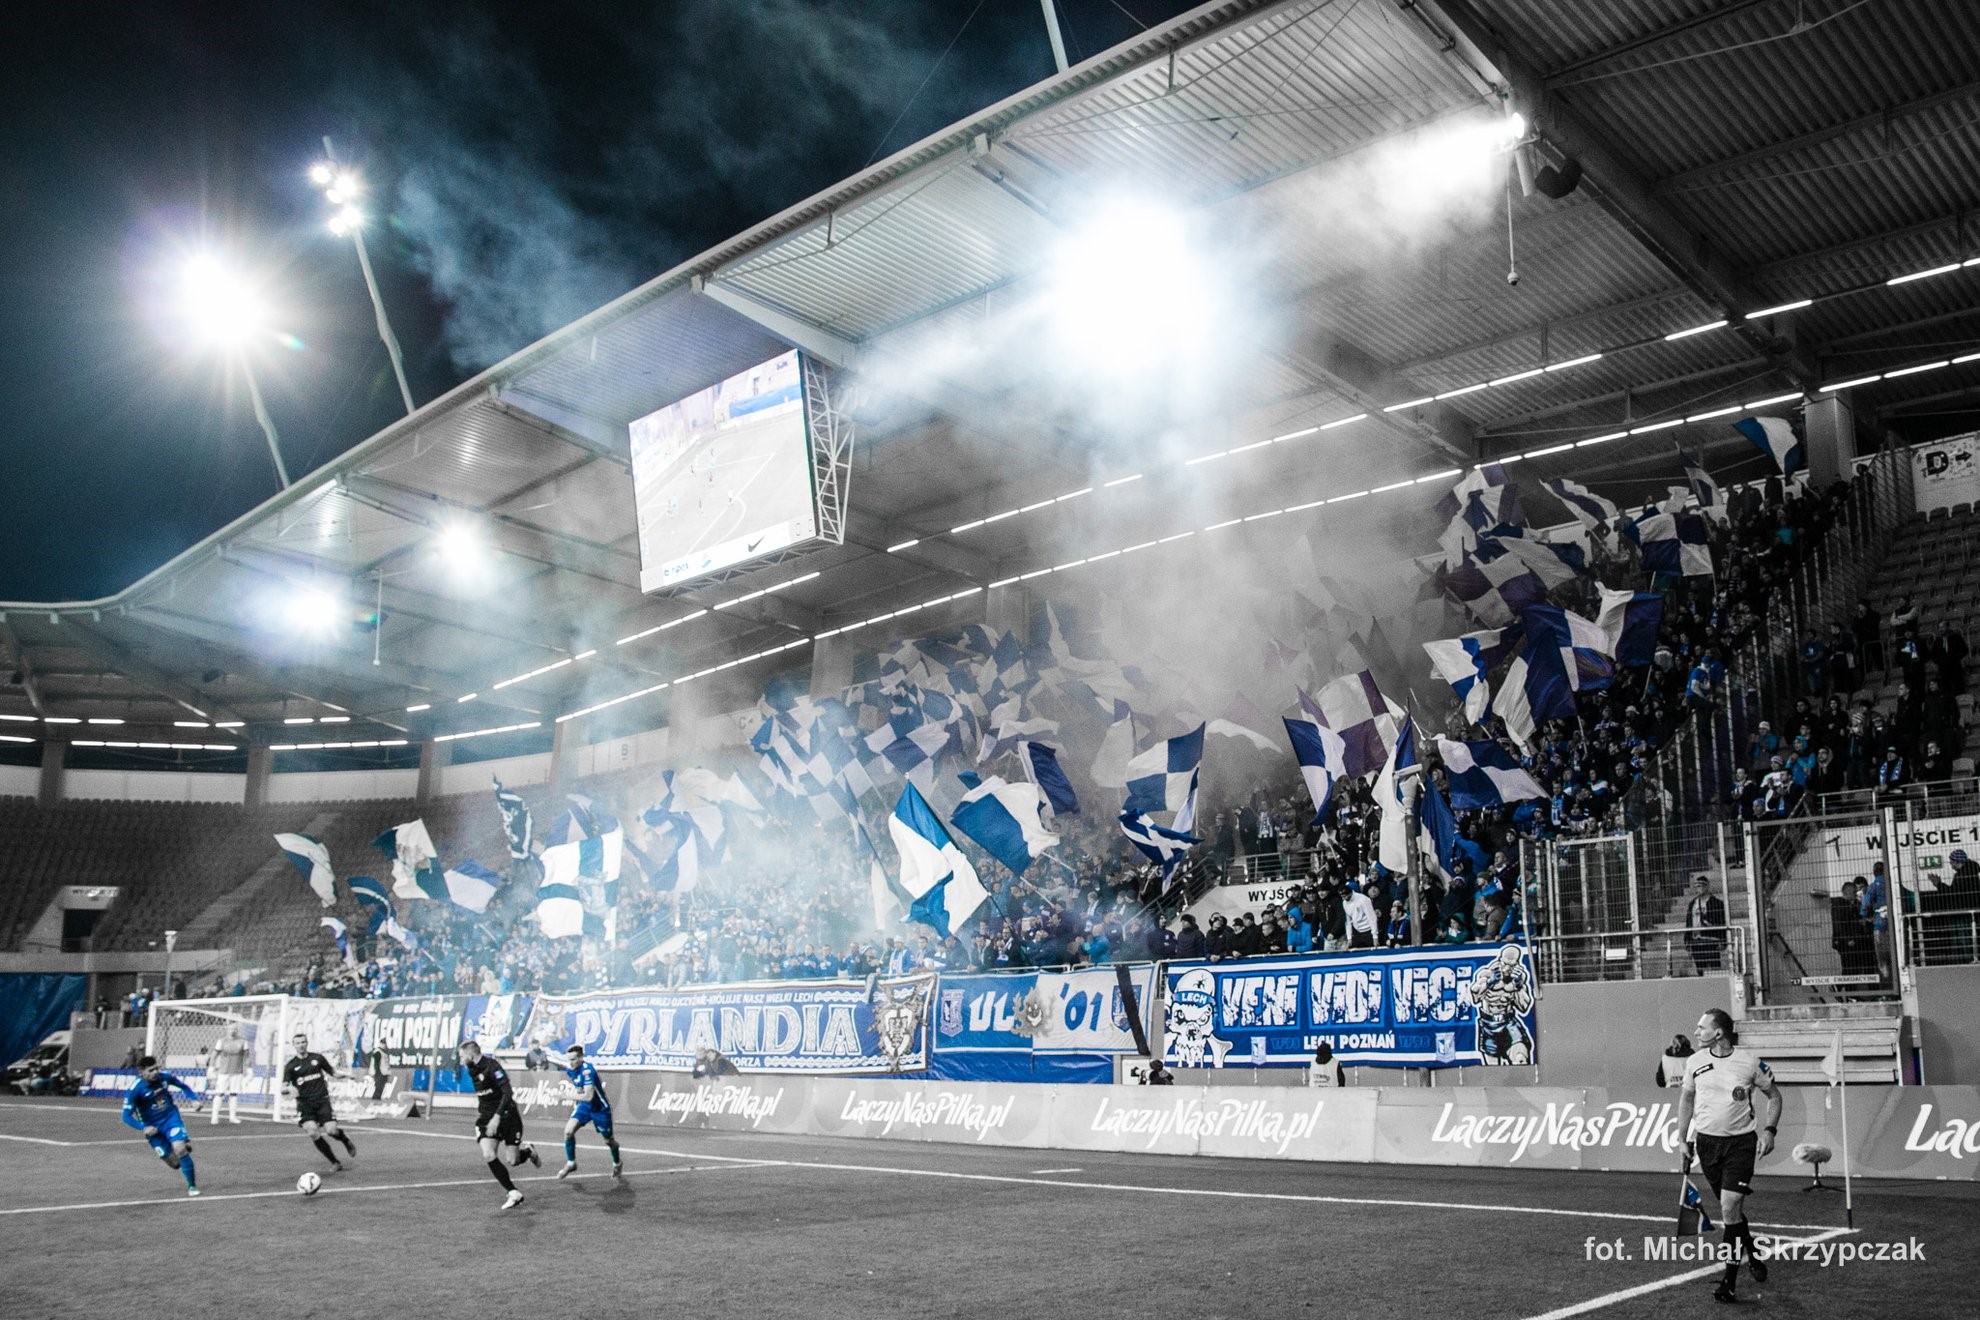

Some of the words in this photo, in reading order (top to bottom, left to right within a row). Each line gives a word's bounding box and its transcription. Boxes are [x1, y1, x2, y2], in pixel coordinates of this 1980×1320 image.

[1926, 451, 1949, 476] D
[1866, 829, 1961, 850] WJŚCIE
[1248, 886, 1292, 902] WYJŚC
[794, 992, 814, 1003] LECH
[1181, 993, 1207, 1004] LECH
[575, 1003, 861, 1055] PYRLANDIA
[1340, 1030, 1395, 1050] POZNAŃ
[645, 1054, 694, 1067] KRÓLESTW
